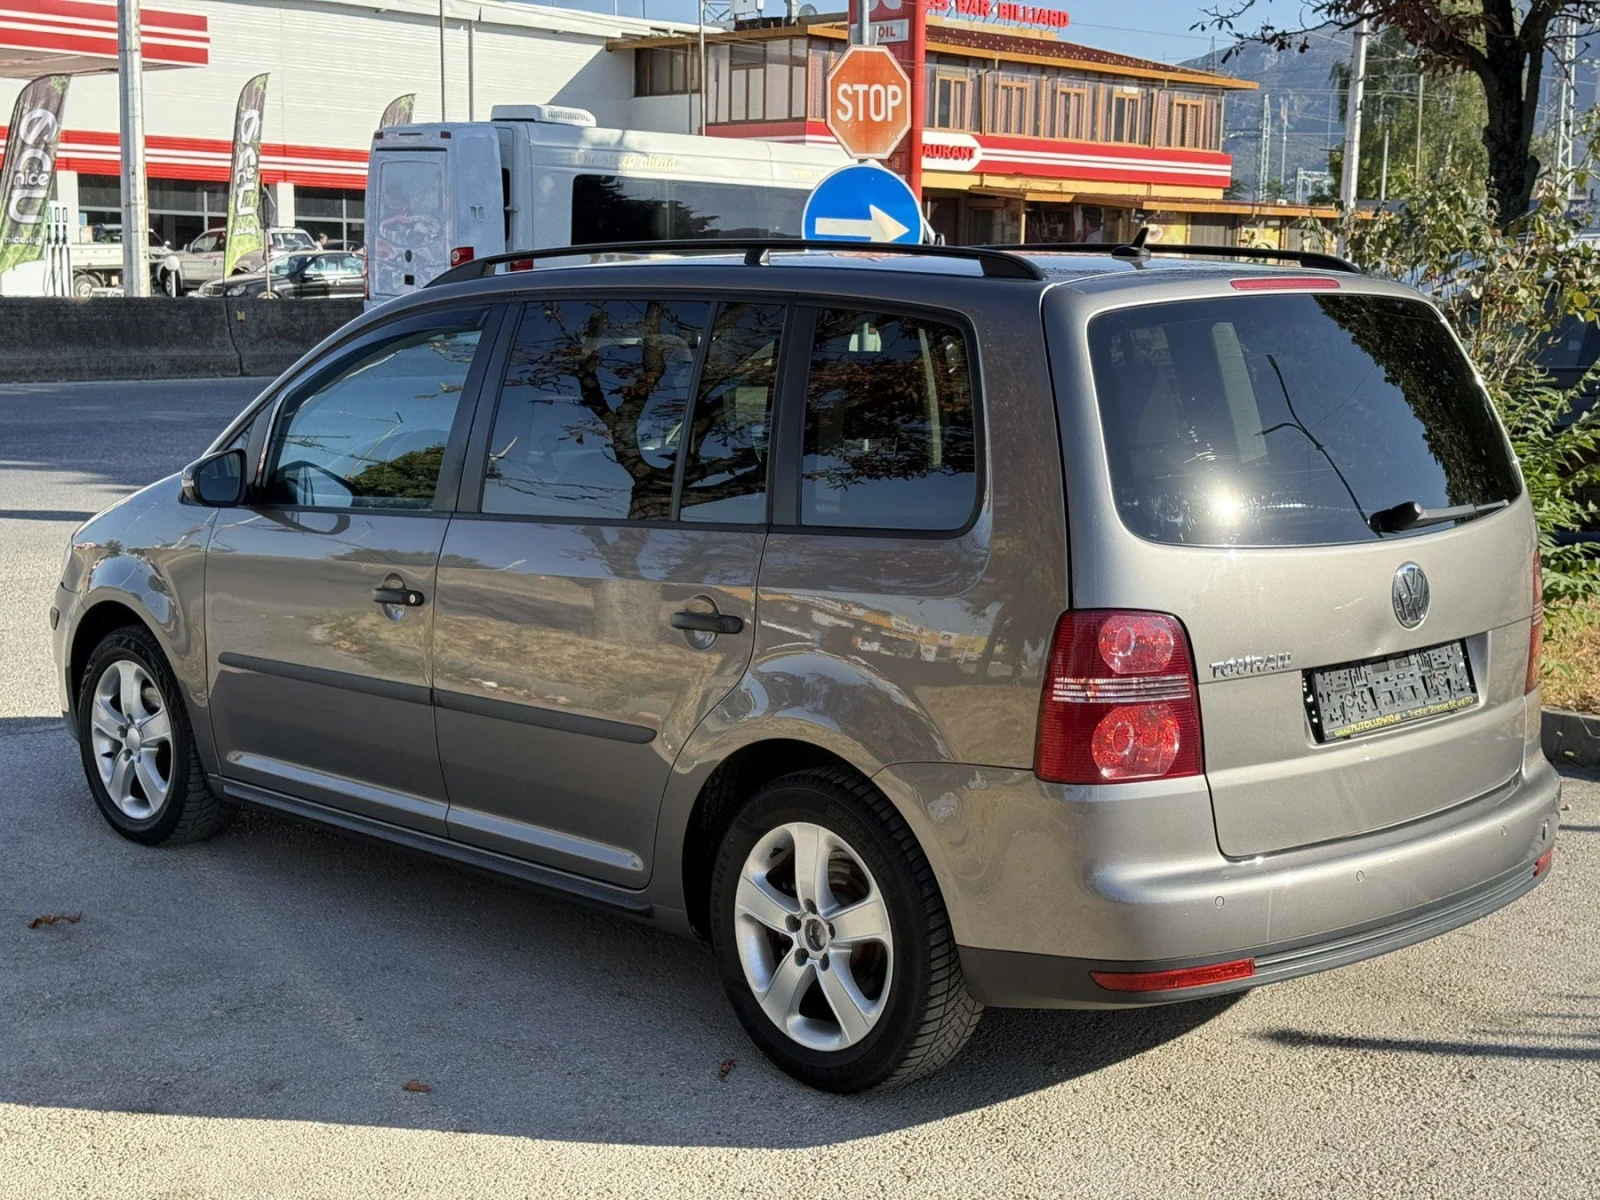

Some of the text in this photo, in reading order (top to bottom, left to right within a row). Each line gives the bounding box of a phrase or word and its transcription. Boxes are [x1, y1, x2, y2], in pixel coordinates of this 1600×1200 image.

[955, 0, 991, 17] BAR
[997, 2, 1070, 28] BILLIARD
[878, 26, 896, 38] OIL
[836, 83, 902, 123] STOP
[13, 168, 49, 187] nice
[1209, 652, 1292, 679] TOURAN
